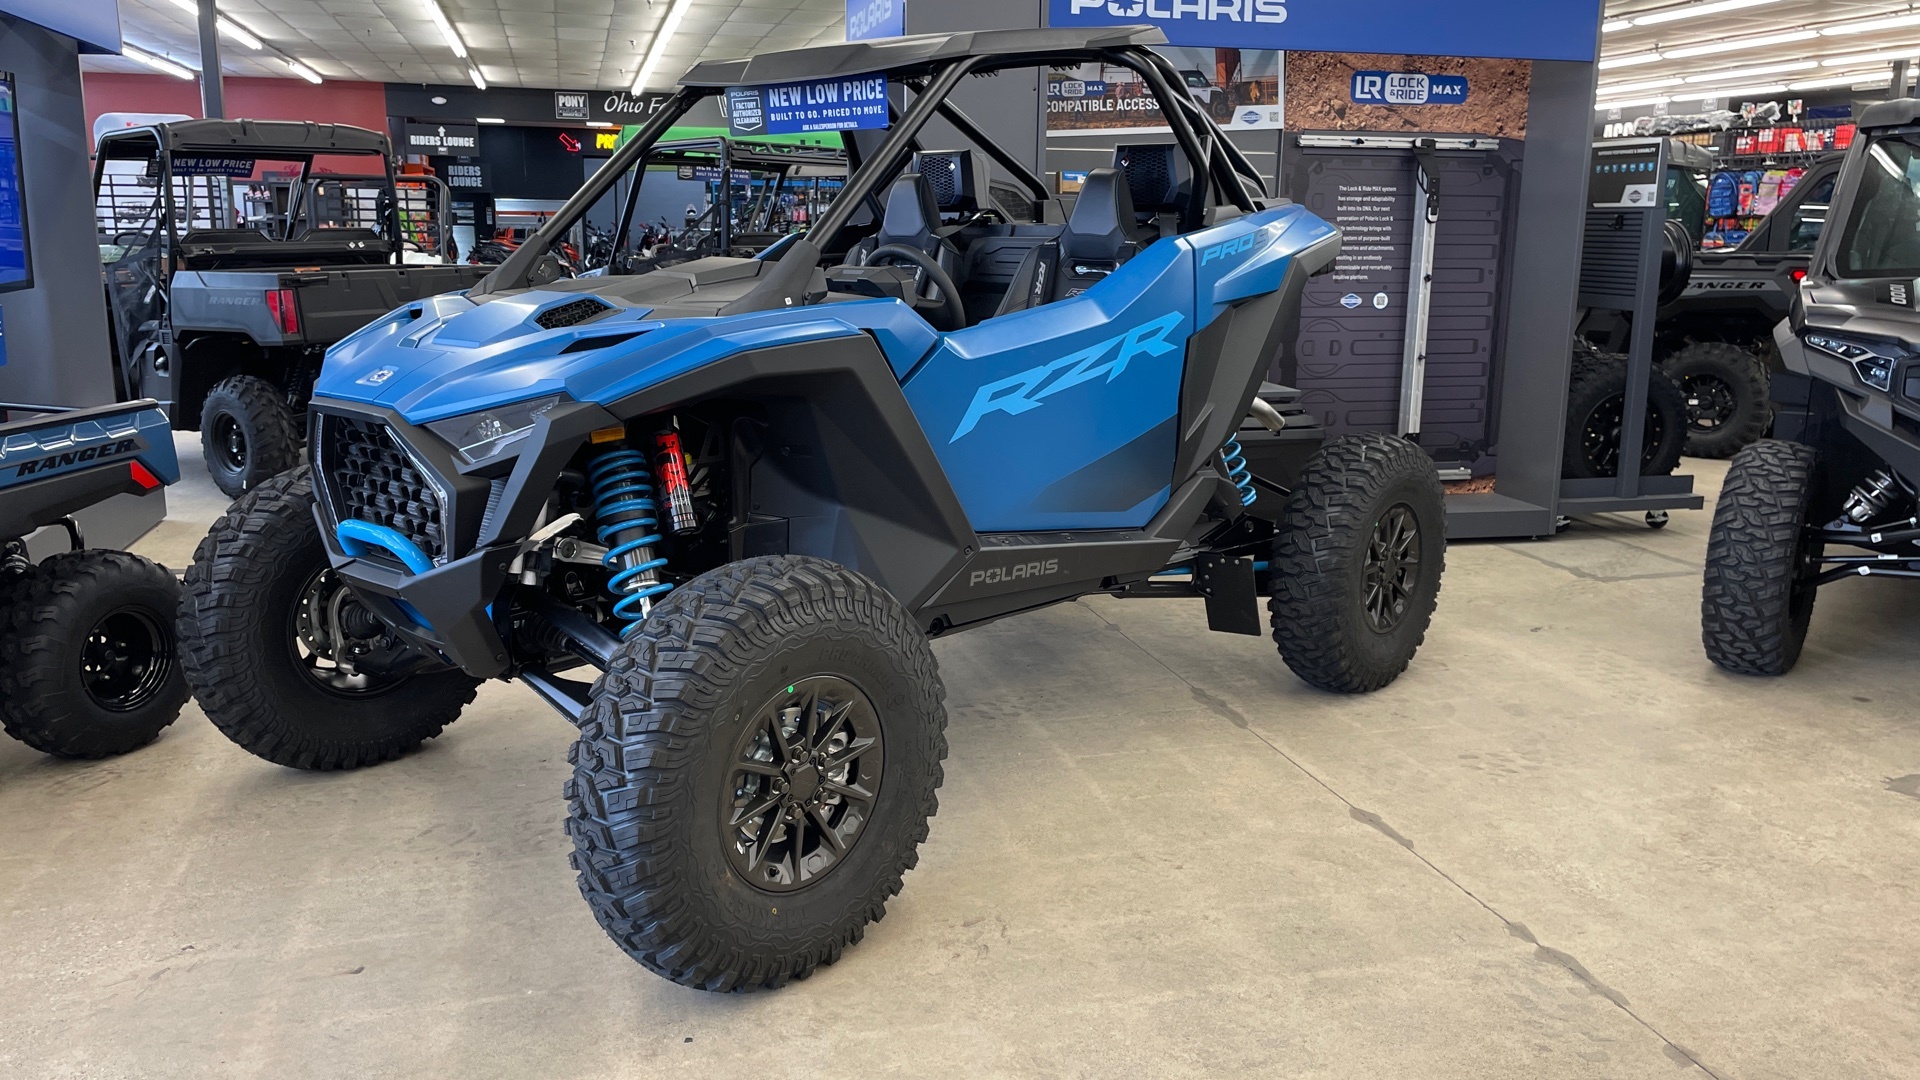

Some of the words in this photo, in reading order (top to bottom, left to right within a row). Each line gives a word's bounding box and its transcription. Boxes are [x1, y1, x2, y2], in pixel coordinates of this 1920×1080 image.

[1355, 76, 1382, 100] LR
[1390, 77, 1424, 88] LOCK
[768, 86, 801, 108] NEW
[806, 82, 839, 104] LOW
[843, 78, 884, 102] PRICE
[1390, 88, 1424, 100] &RIDE
[1432, 84, 1462, 95] MAX
[558, 95, 584, 108] PONY
[604, 92, 644, 113] Ohio
[736, 101, 756, 110] FACTORY
[733, 108, 762, 118] AUTHORIZED
[770, 112, 792, 121] BUILT
[795, 111, 804, 119] TO
[808, 110, 820, 118] GO.
[823, 108, 850, 118] PRICED
[853, 107, 862, 115] TO
[864, 105, 884, 114] MOVE.
[410, 135, 441, 146] RIDERS
[442, 136, 474, 147] LOUNGE
[174, 158, 196, 167] NEW
[199, 159, 221, 167] LOW
[222, 160, 252, 168] PRICE
[448, 165, 481, 176] RIDERS
[448, 176, 482, 187] LOUNGE
[1201, 232, 1255, 266] PRO
[1254, 228, 1269, 249] S
[1034, 262, 1046, 294] RZR
[208, 296, 261, 306] RANGER
[949, 310, 1186, 444] RZR
[16, 438, 136, 477] RANGER
[970, 559, 1058, 586] POLARIS
